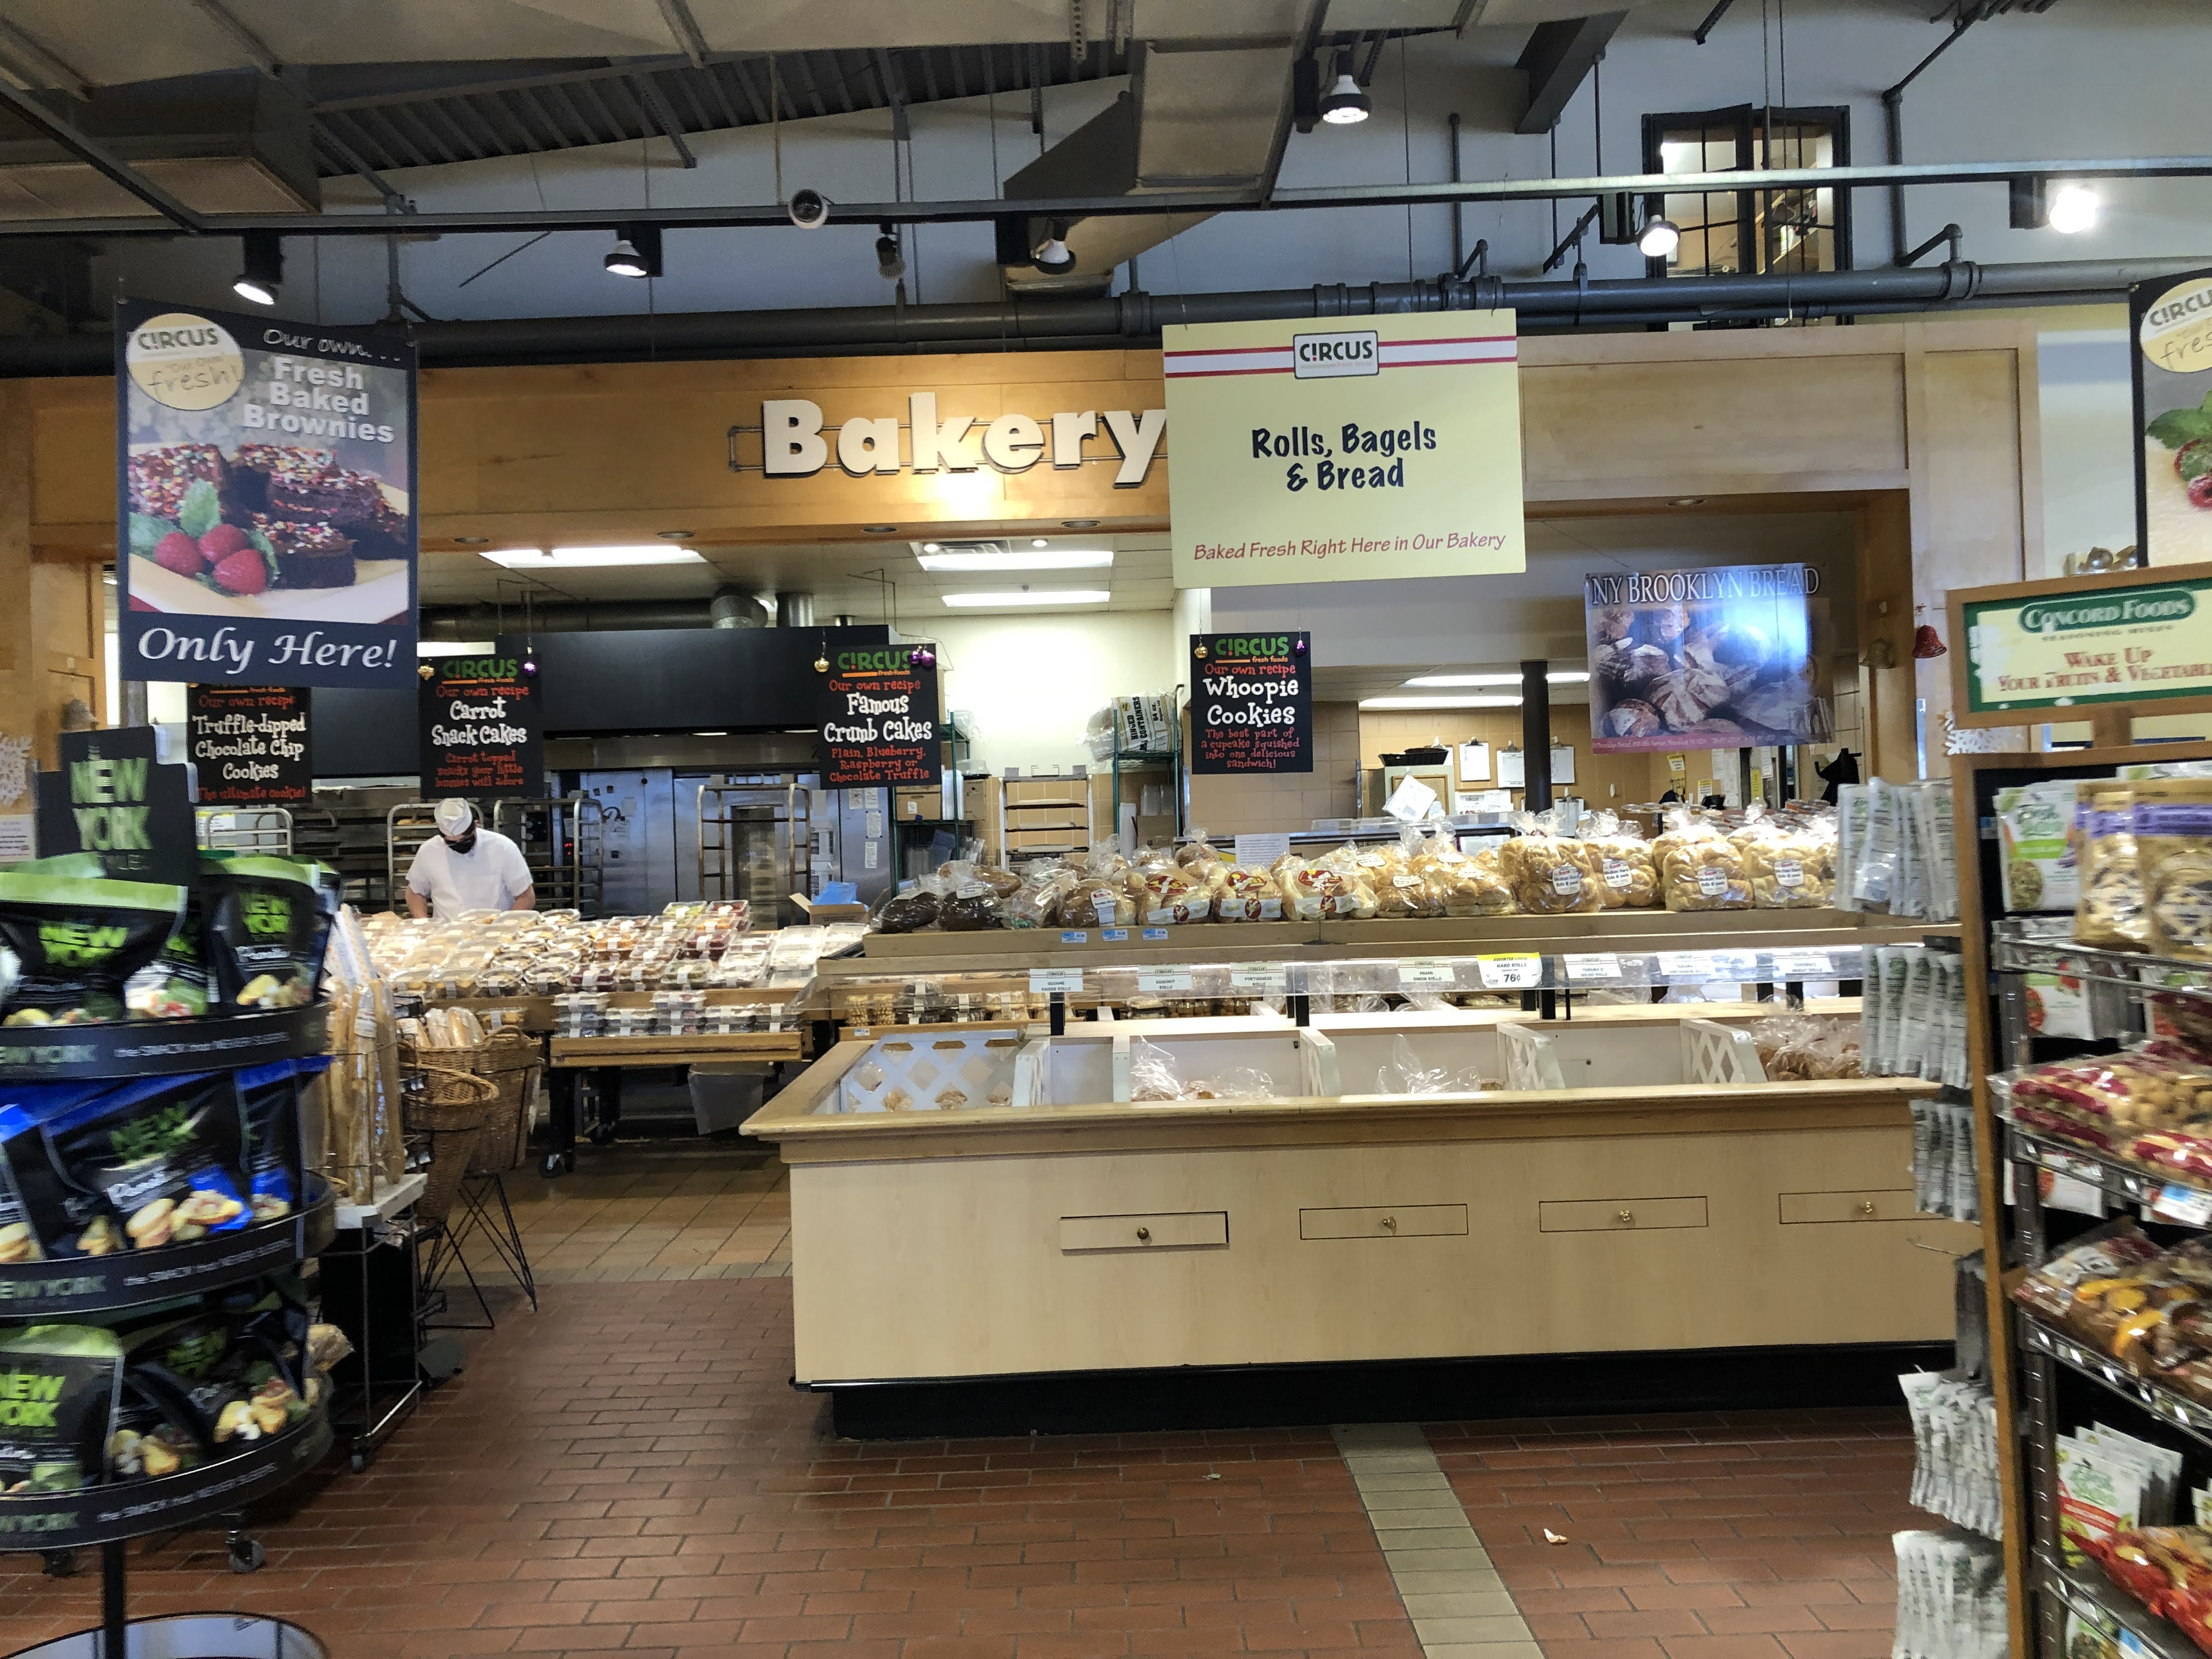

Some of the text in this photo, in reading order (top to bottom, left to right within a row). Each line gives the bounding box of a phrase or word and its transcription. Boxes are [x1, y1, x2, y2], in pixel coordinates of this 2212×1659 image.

[263, 329, 313, 348] Our
[275, 358, 363, 390] Fresh
[269, 381, 369, 415] Baked
[244, 404, 394, 443] Brownies
[763, 392, 1165, 488] Bakery
[1251, 421, 1436, 459] Rolls, Bagels
[1286, 458, 1404, 492] & Bread
[1194, 532, 1505, 560] Baked Fresh Right Here in Our Bakery
[1592, 566, 1820, 605] NY BROOKLYN BREAD
[138, 627, 397, 674] Only Here!
[1204, 663, 1228, 675] Our
[1259, 664, 1296, 678] recipe
[2106, 666, 2122, 682] &
[436, 686, 530, 700] Our own recipe
[829, 679, 921, 695] Our own recipe
[1203, 675, 1299, 704] Whoopie
[199, 695, 225, 708] Our
[228, 698, 255, 707] own
[450, 696, 507, 720] Carrot
[847, 692, 910, 715] Famous
[192, 712, 307, 739] Truffle-dipped
[1207, 702, 1296, 727] Cookies
[431, 723, 528, 747] Snack Cakes
[824, 716, 933, 743] Crumb Cakes
[1205, 726, 1294, 740] The best part of
[195, 735, 305, 761] Chocolate Chip
[831, 744, 926, 760] Plain, Blueberry,
[1205, 749, 1225, 759] into
[1251, 748, 1296, 758] delicious
[1210, 739, 1250, 751] cupcake
[1255, 737, 1300, 751] squished
[222, 760, 280, 781] Cookies
[829, 768, 930, 783] Chocolate Truffle
[840, 758, 901, 772] Raspberry
[1226, 758, 1277, 769] sandwich!
[70, 757, 150, 803] NEW
[1503, 974, 1521, 982] 76¢
